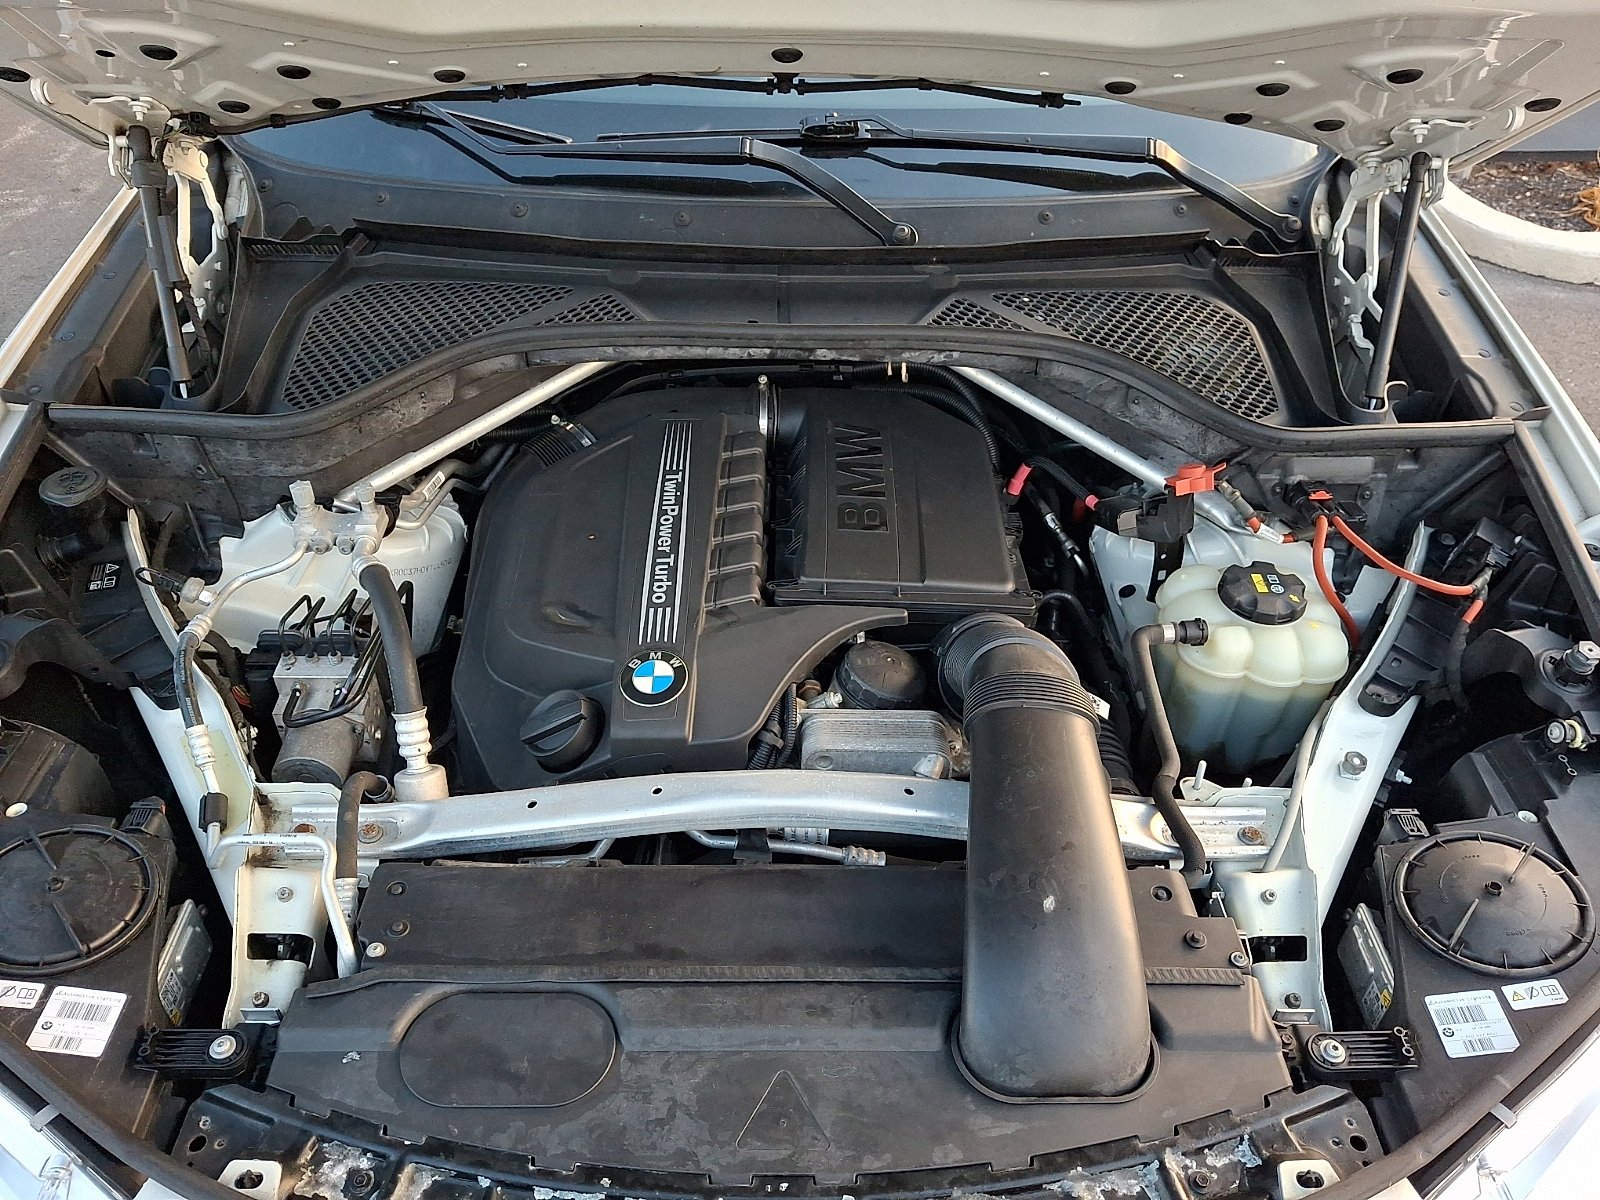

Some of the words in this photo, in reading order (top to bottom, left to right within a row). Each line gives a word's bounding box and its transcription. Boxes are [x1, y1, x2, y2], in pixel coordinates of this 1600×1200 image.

[835, 422, 888, 533] BMW
[657, 471, 682, 552] TwinPower
[652, 554, 674, 604] Turbo
[628, 652, 682, 669] BMW
